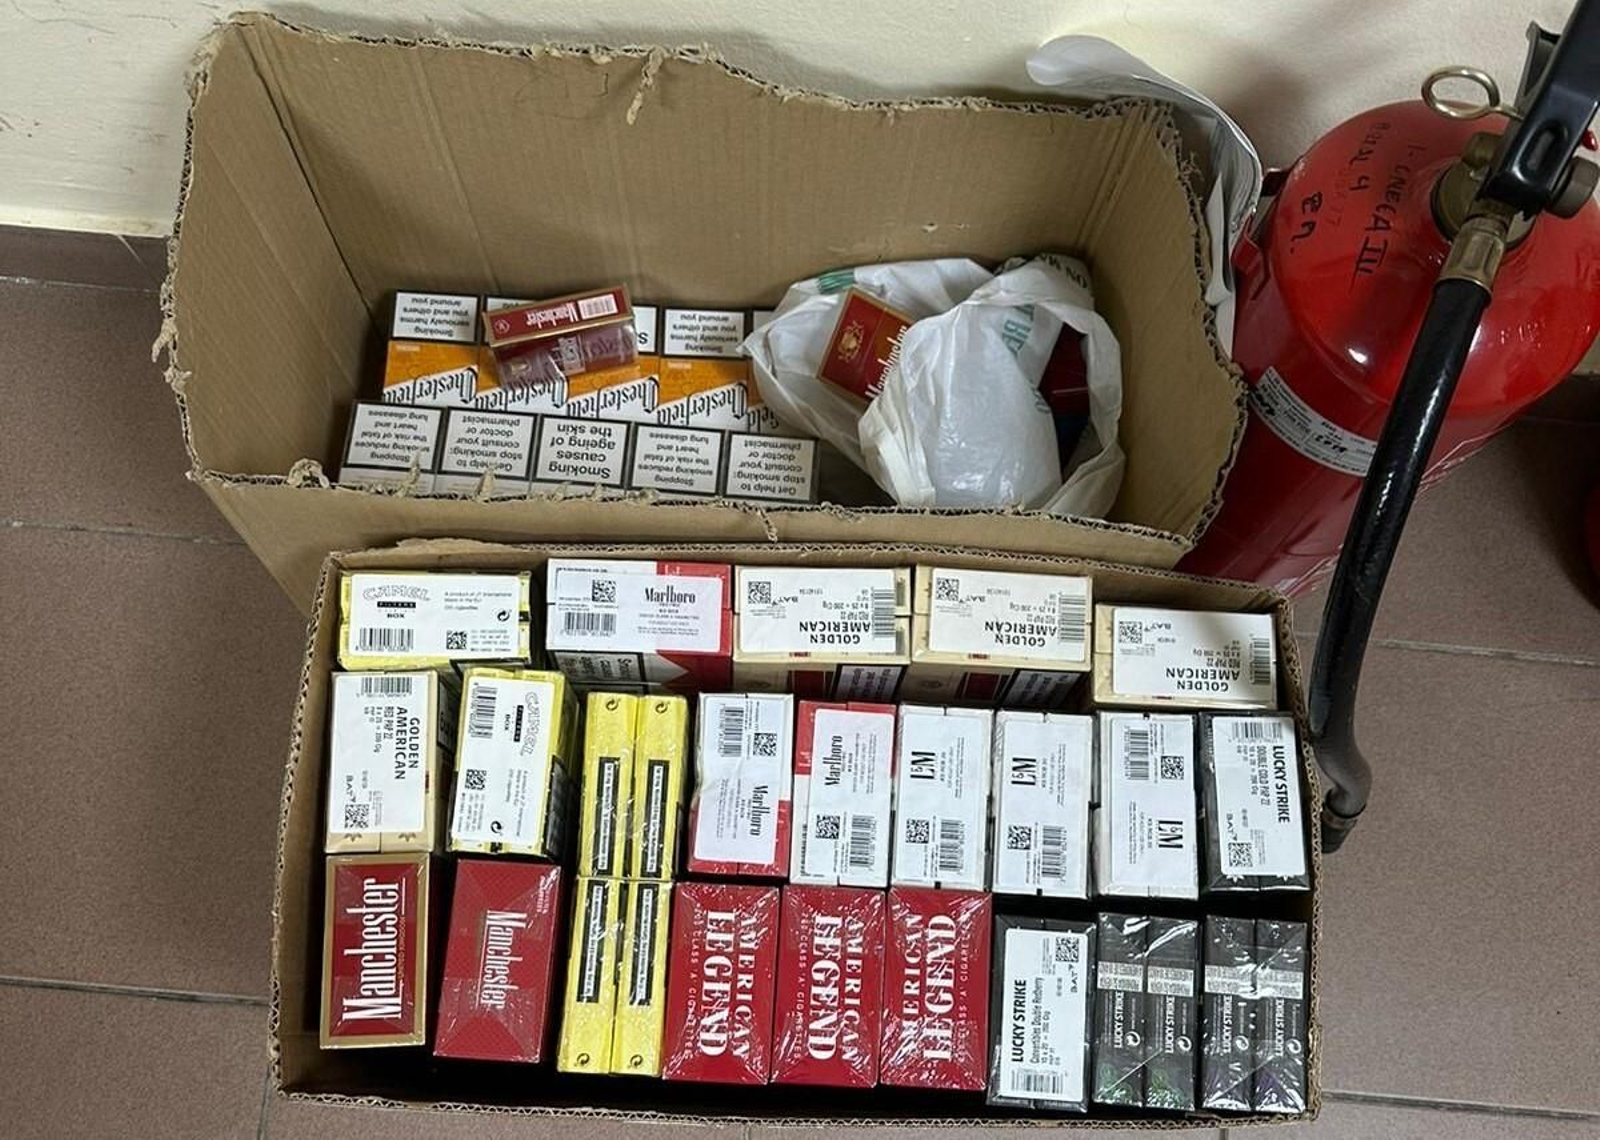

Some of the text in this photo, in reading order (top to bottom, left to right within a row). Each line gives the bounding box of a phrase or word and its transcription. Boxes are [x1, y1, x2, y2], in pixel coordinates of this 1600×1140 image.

[526, 302, 579, 329] Manchester
[462, 416, 520, 427] pharmacist
[465, 427, 513, 438] doctor or
[557, 424, 612, 437] the skin
[450, 447, 522, 460] stop smoking:
[456, 436, 519, 449] consult your
[549, 436, 616, 450] ageing of
[744, 439, 801, 451] pharmacist
[747, 451, 795, 462] doctor or
[456, 459, 467, 467] to
[548, 461, 611, 479] Smoking
[556, 450, 606, 464] causes
[738, 460, 802, 472] consult your
[654, 475, 694, 486] Stopping
[733, 470, 805, 484] stop smoking:
[740, 482, 797, 496] Get help to
[362, 584, 432, 602] CAMEL
[645, 585, 696, 604] Marlboro
[799, 621, 871, 632] AMERICAN
[809, 634, 860, 644] GOLDEN
[984, 621, 1057, 636] AMERICAN
[994, 634, 1045, 647] GOLDEN
[1165, 668, 1240, 680] AMERICAN
[1176, 680, 1229, 692] GOLDEN
[519, 691, 540, 757] CAMEL
[394, 706, 407, 780] AMERICAN
[408, 717, 420, 769] GOLDEN
[822, 735, 843, 786] Marlboro
[909, 751, 936, 779] L&M
[1011, 757, 1037, 786] L&M
[1272, 745, 1290, 823] LUCKY STRIKE
[750, 785, 771, 836] Marlboro
[1158, 820, 1183, 849] L&M
[342, 878, 402, 1020] Manchester
[480, 910, 528, 1010] Manchester
[691, 931, 702, 964] CLASS
[799, 935, 808, 968] CLASS
[699, 909, 736, 1056] LEGEND
[731, 913, 757, 1060] AMERICAN
[807, 914, 843, 1060] LEGEND
[841, 916, 864, 1061] AMERICAN
[901, 913, 923, 1056] AMERICAN
[923, 915, 956, 1062] LEGEND
[958, 1005, 968, 1039] CLASS
[1011, 979, 1026, 1062] LUCKY STRIKE
[1114, 991, 1124, 1048] LUCKY STRIKE
[1165, 995, 1175, 1053] LUCKY STRIKE
[1223, 995, 1233, 1052] LUCKY STRIKE
[1275, 998, 1285, 1056] LUCKY STRIKE
